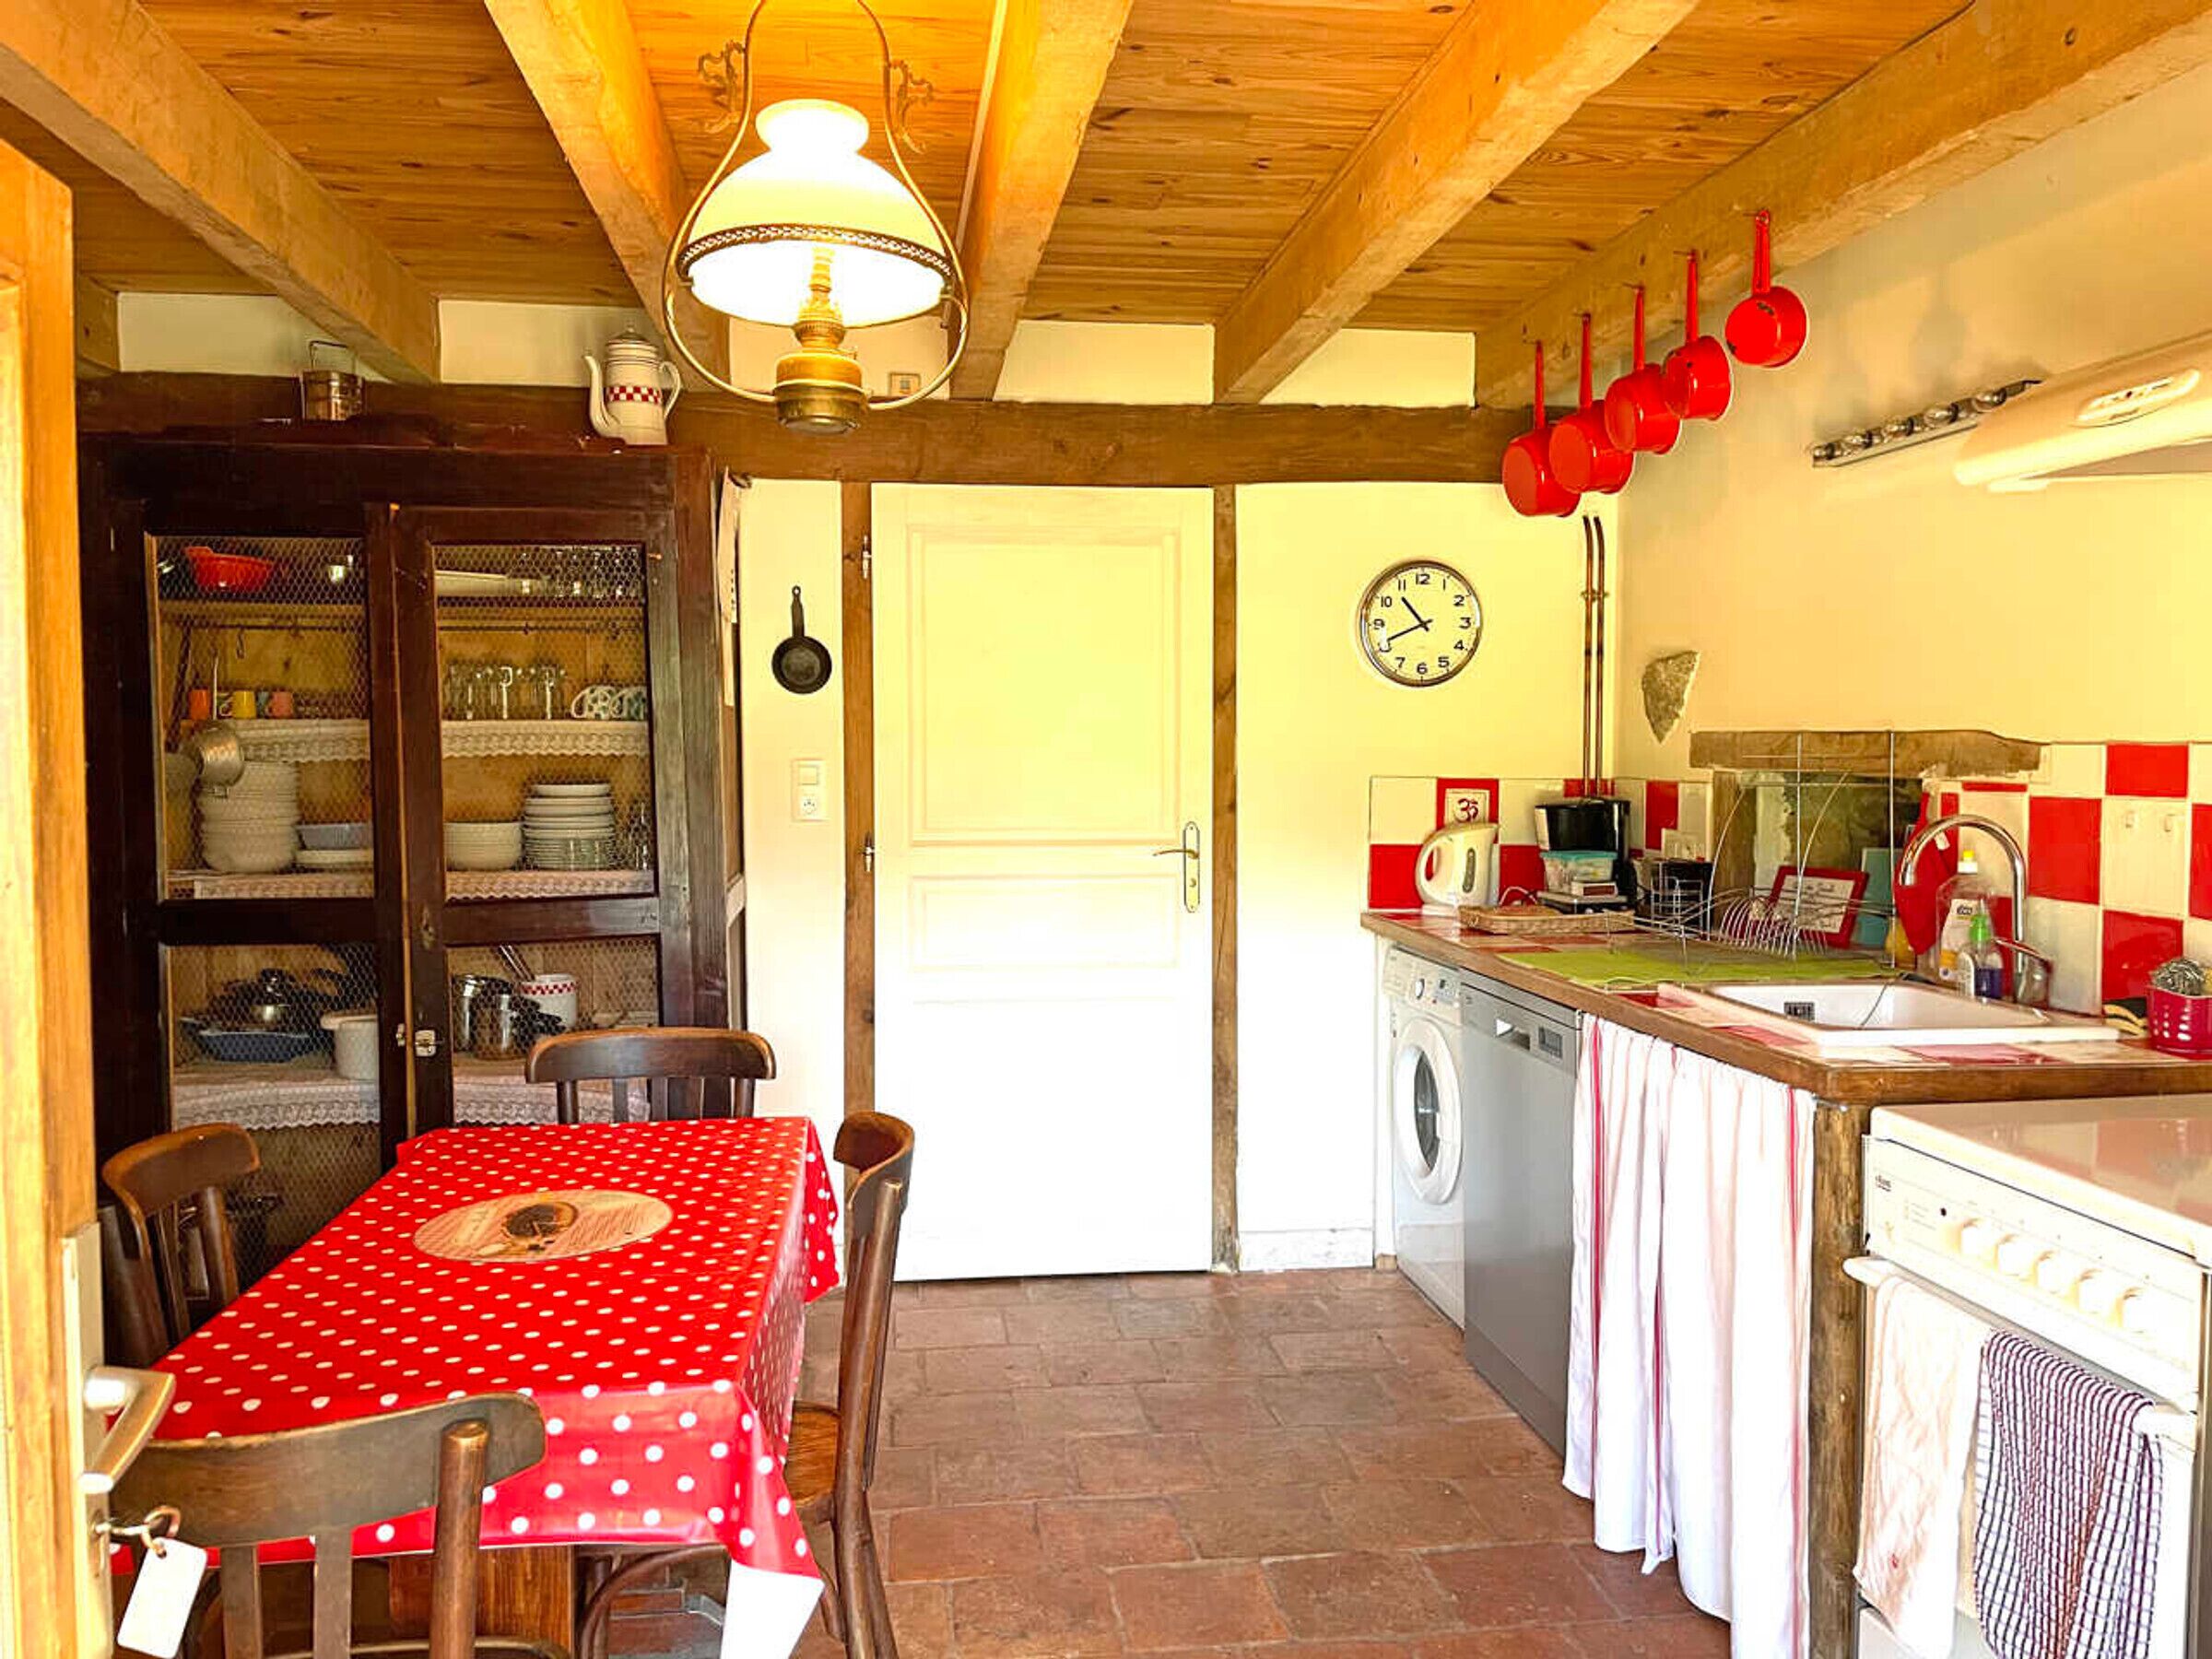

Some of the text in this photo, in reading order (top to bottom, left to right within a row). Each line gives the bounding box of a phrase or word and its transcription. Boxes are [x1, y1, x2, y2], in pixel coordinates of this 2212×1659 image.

[1416, 573, 1430, 585] 12
[1397, 579, 1406, 592] 11
[1381, 596, 1393, 607] 10
[1453, 594, 1465, 606] 2
[1373, 618, 1385, 629] 9
[1460, 617, 1472, 629] 3
[1453, 640, 1465, 651] 4
[1394, 656, 1406, 668] 7
[1438, 656, 1450, 668] 5
[1417, 662, 1428, 675] 6
